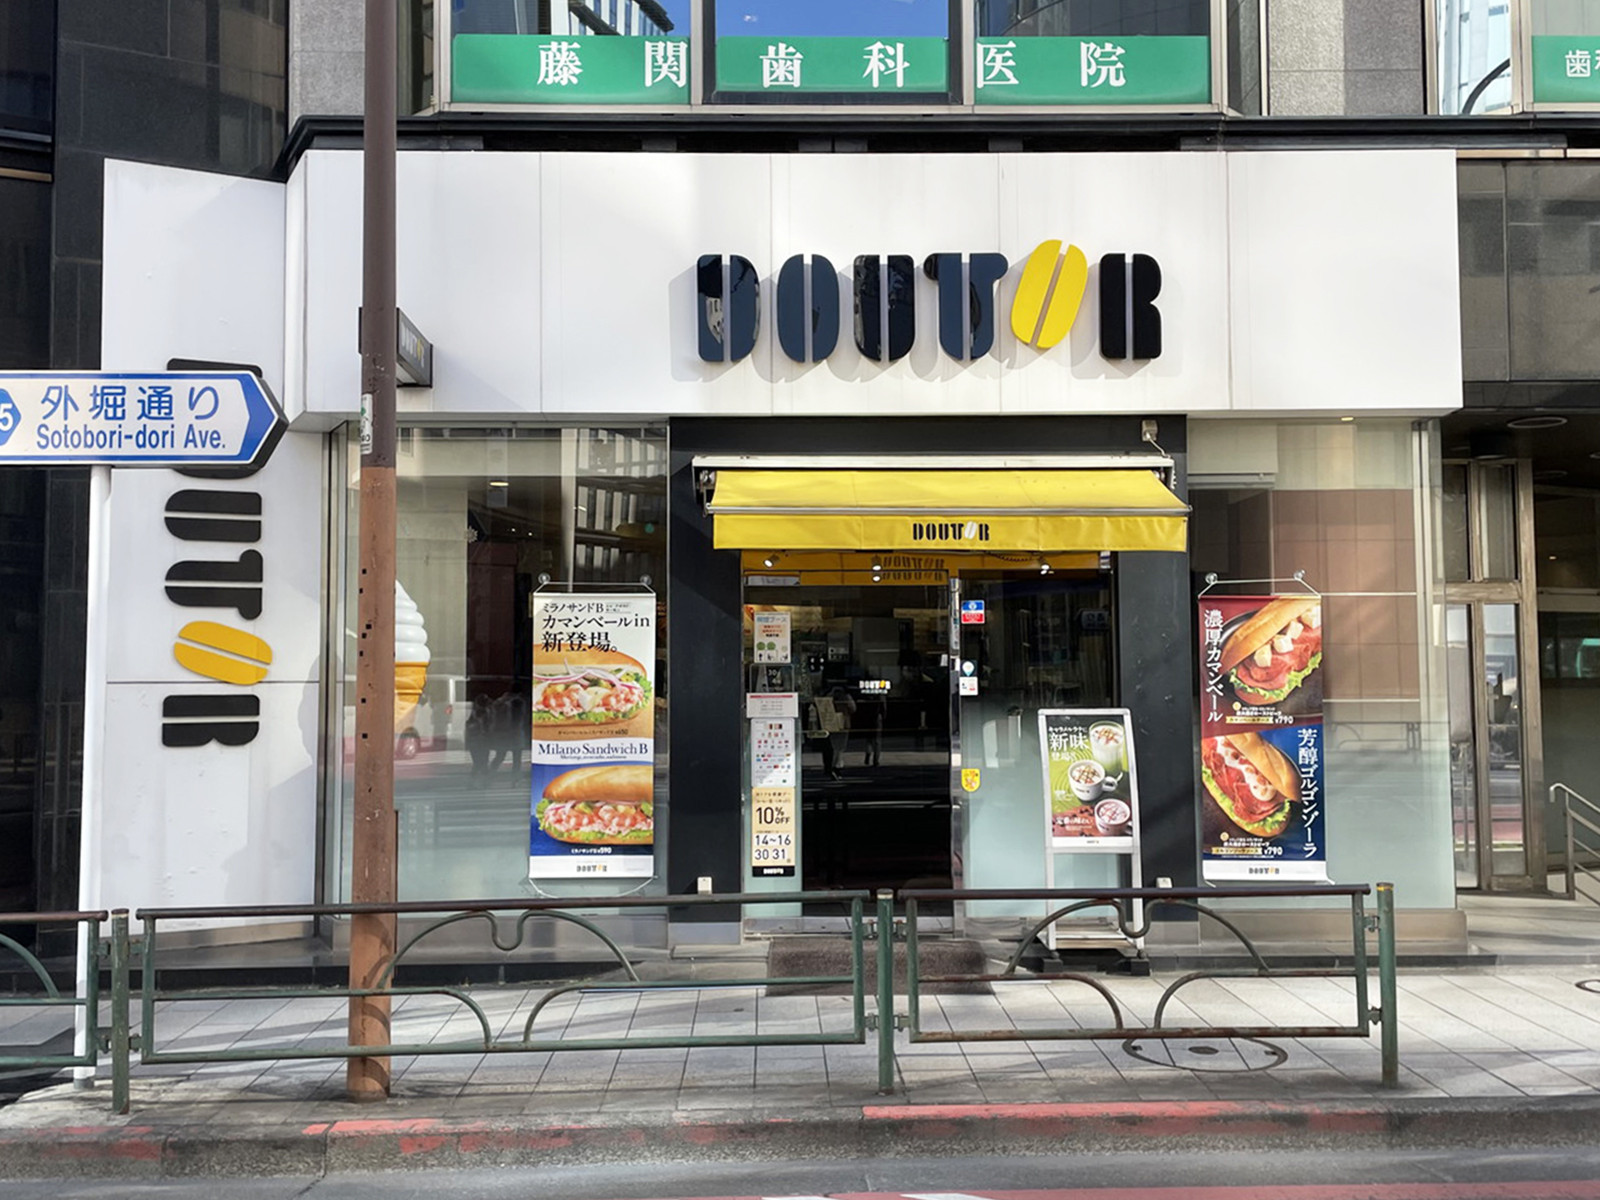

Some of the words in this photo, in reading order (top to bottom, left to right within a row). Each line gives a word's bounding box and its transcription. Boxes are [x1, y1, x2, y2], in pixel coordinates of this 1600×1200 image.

[537, 40, 1126, 88] 藤関歯科医院
[1565, 50, 1600, 77] 歯
[697, 239, 1162, 363] DOUTOR
[41, 385, 220, 421] 外堀通り
[37, 424, 175, 449] Sotobori-dori
[184, 424, 226, 449] Ave.
[913, 521, 990, 541] DOUTOR
[543, 613, 650, 629] カマンベールin
[541, 631, 617, 652] 新登場。
[1204, 609, 1224, 722] 濃厚カマンベール
[538, 743, 581, 755] Milano
[582, 743, 637, 755] Sandwich
[639, 743, 649, 754] B
[1298, 728, 1319, 858] 芳醇ゴルゴンゾーラ
